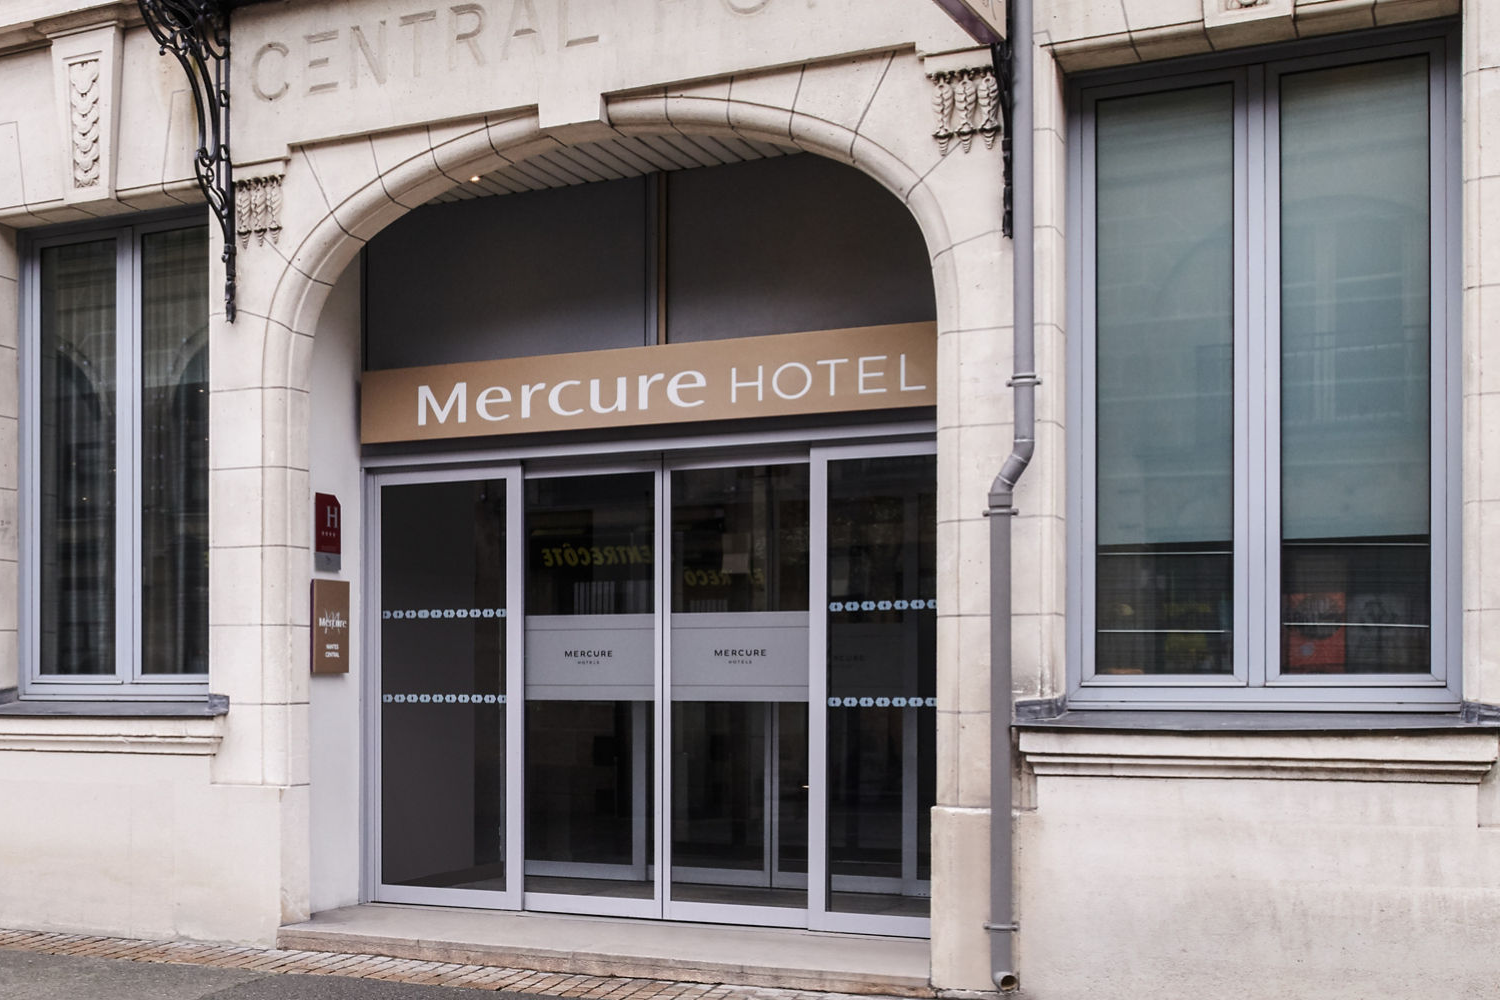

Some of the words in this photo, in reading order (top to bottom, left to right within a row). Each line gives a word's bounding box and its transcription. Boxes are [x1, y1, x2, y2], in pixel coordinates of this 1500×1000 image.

[417, 369, 708, 426] Mercure
[730, 353, 927, 404] HOTEL
[326, 505, 338, 529] H
[564, 650, 613, 658] MERCURE
[713, 648, 767, 657] MERCURE
